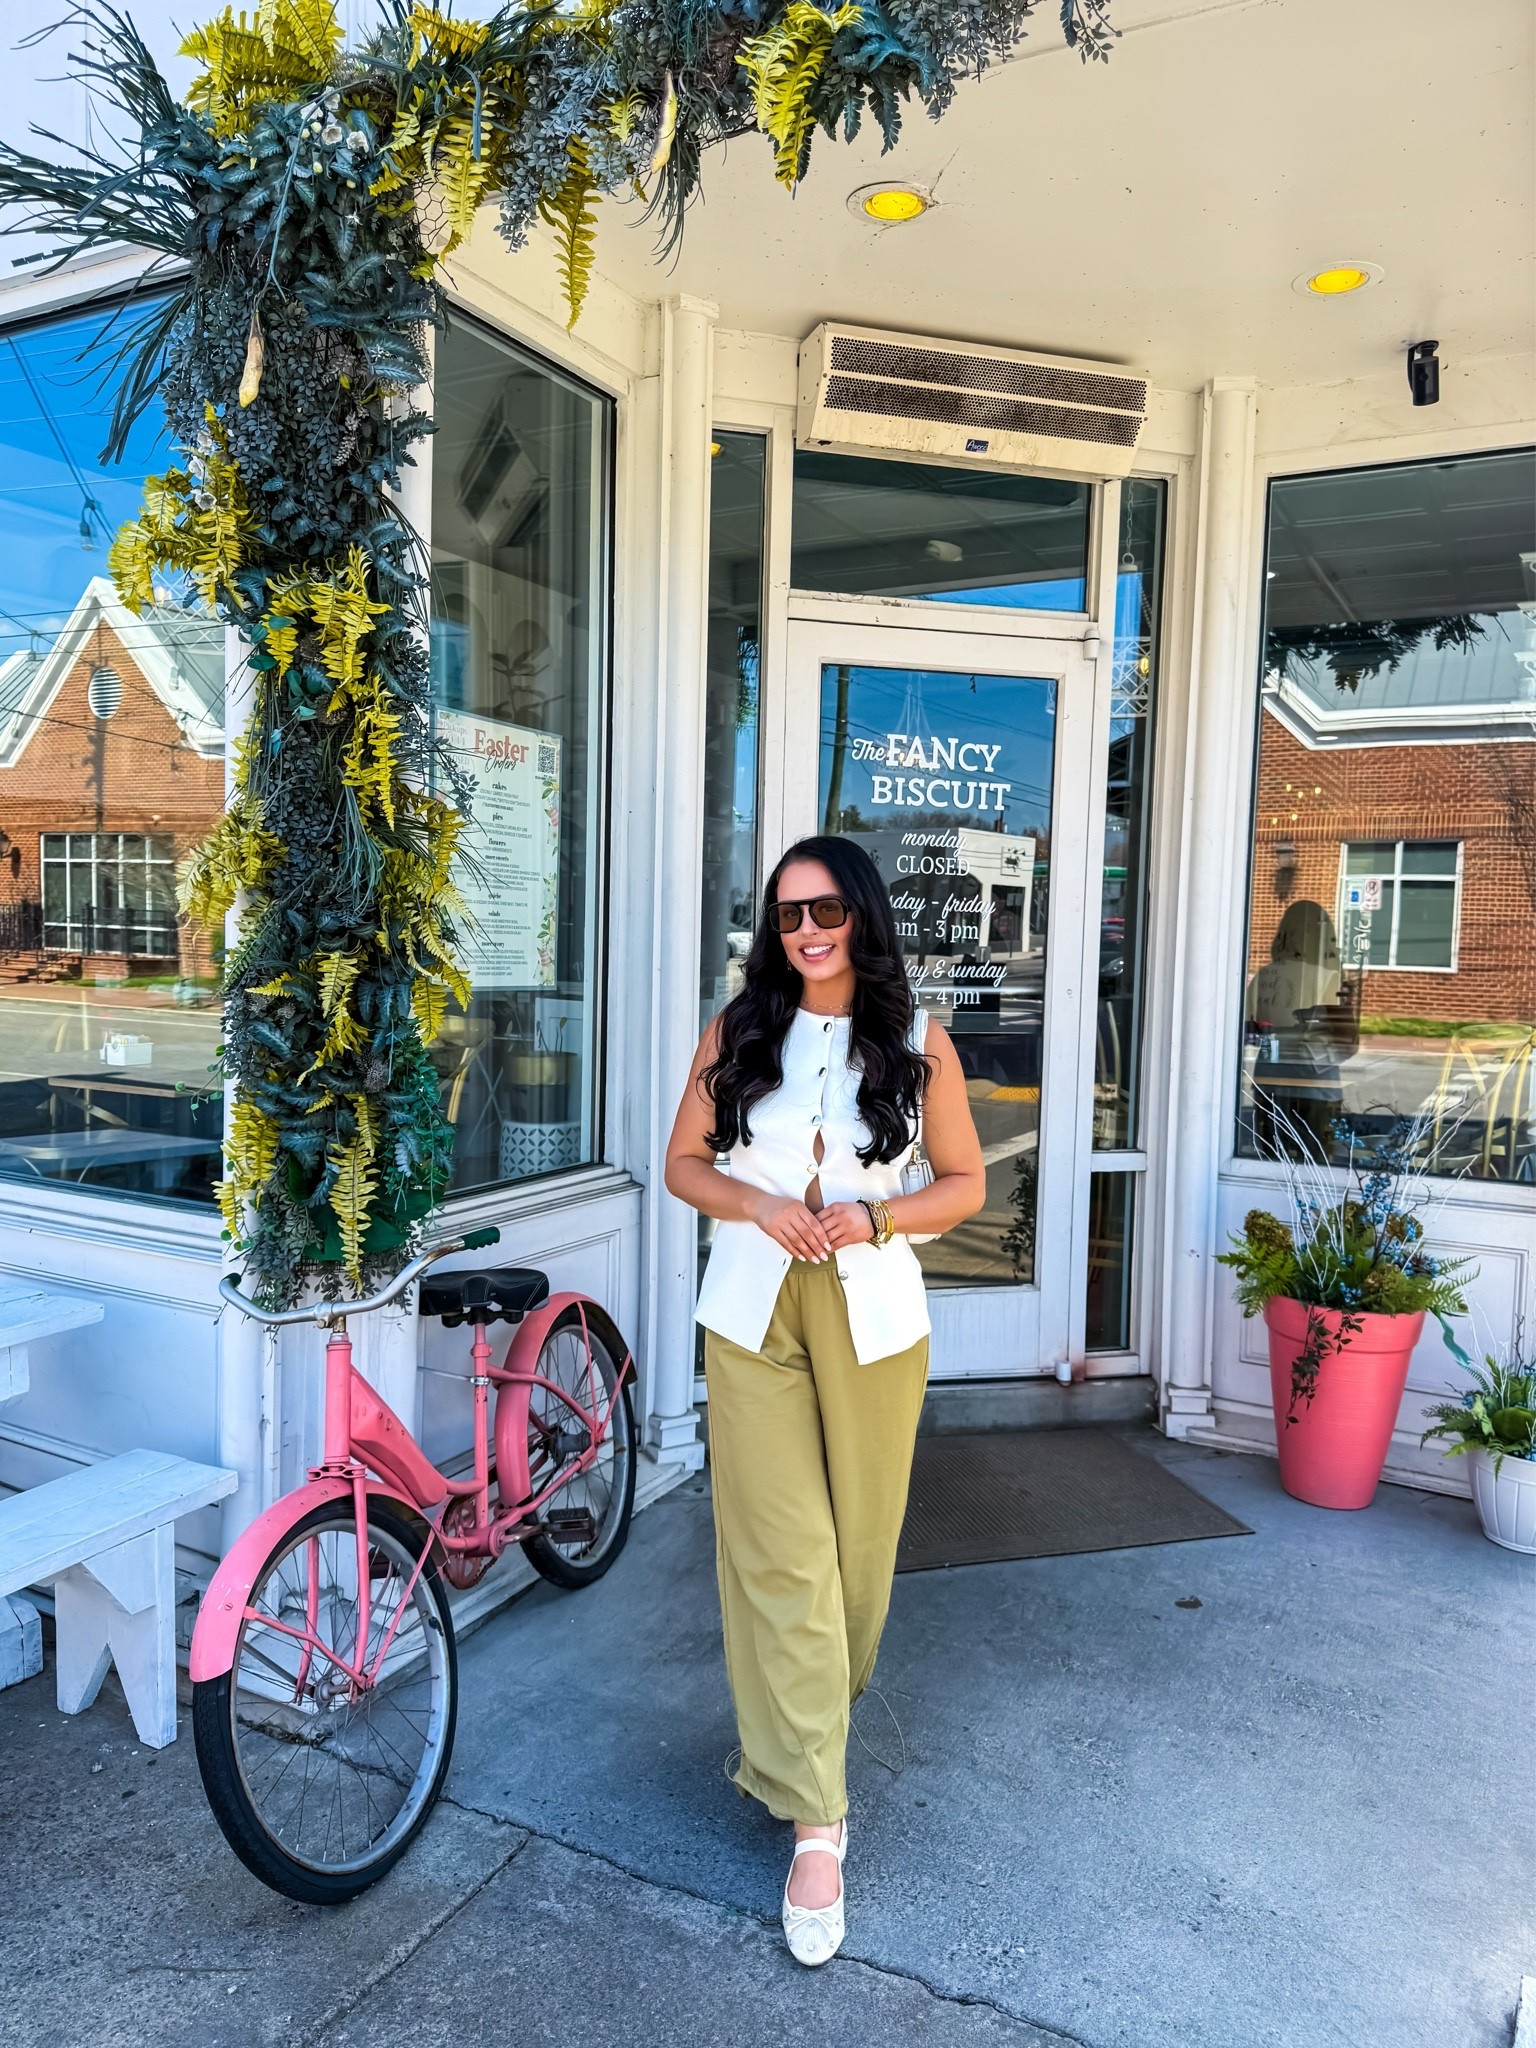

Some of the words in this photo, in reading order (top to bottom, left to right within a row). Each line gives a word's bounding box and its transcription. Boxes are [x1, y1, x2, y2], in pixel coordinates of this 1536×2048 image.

[474, 728, 529, 763] Easter
[851, 738, 886, 761] The
[885, 733, 1002, 773] FANCY
[485, 749, 517, 773] Orders
[870, 775, 1011, 811] BISCUIT
[492, 812, 503, 821] pies
[900, 829, 968, 857] monday
[896, 855, 970, 876] CLOSED
[941, 893, 996, 922] friday
[935, 920, 946, 938] 3
[950, 924, 979, 943] pm
[932, 959, 946, 978] &
[947, 959, 1008, 988] sunday
[936, 987, 948, 1005] 4
[952, 990, 981, 1009] pm
